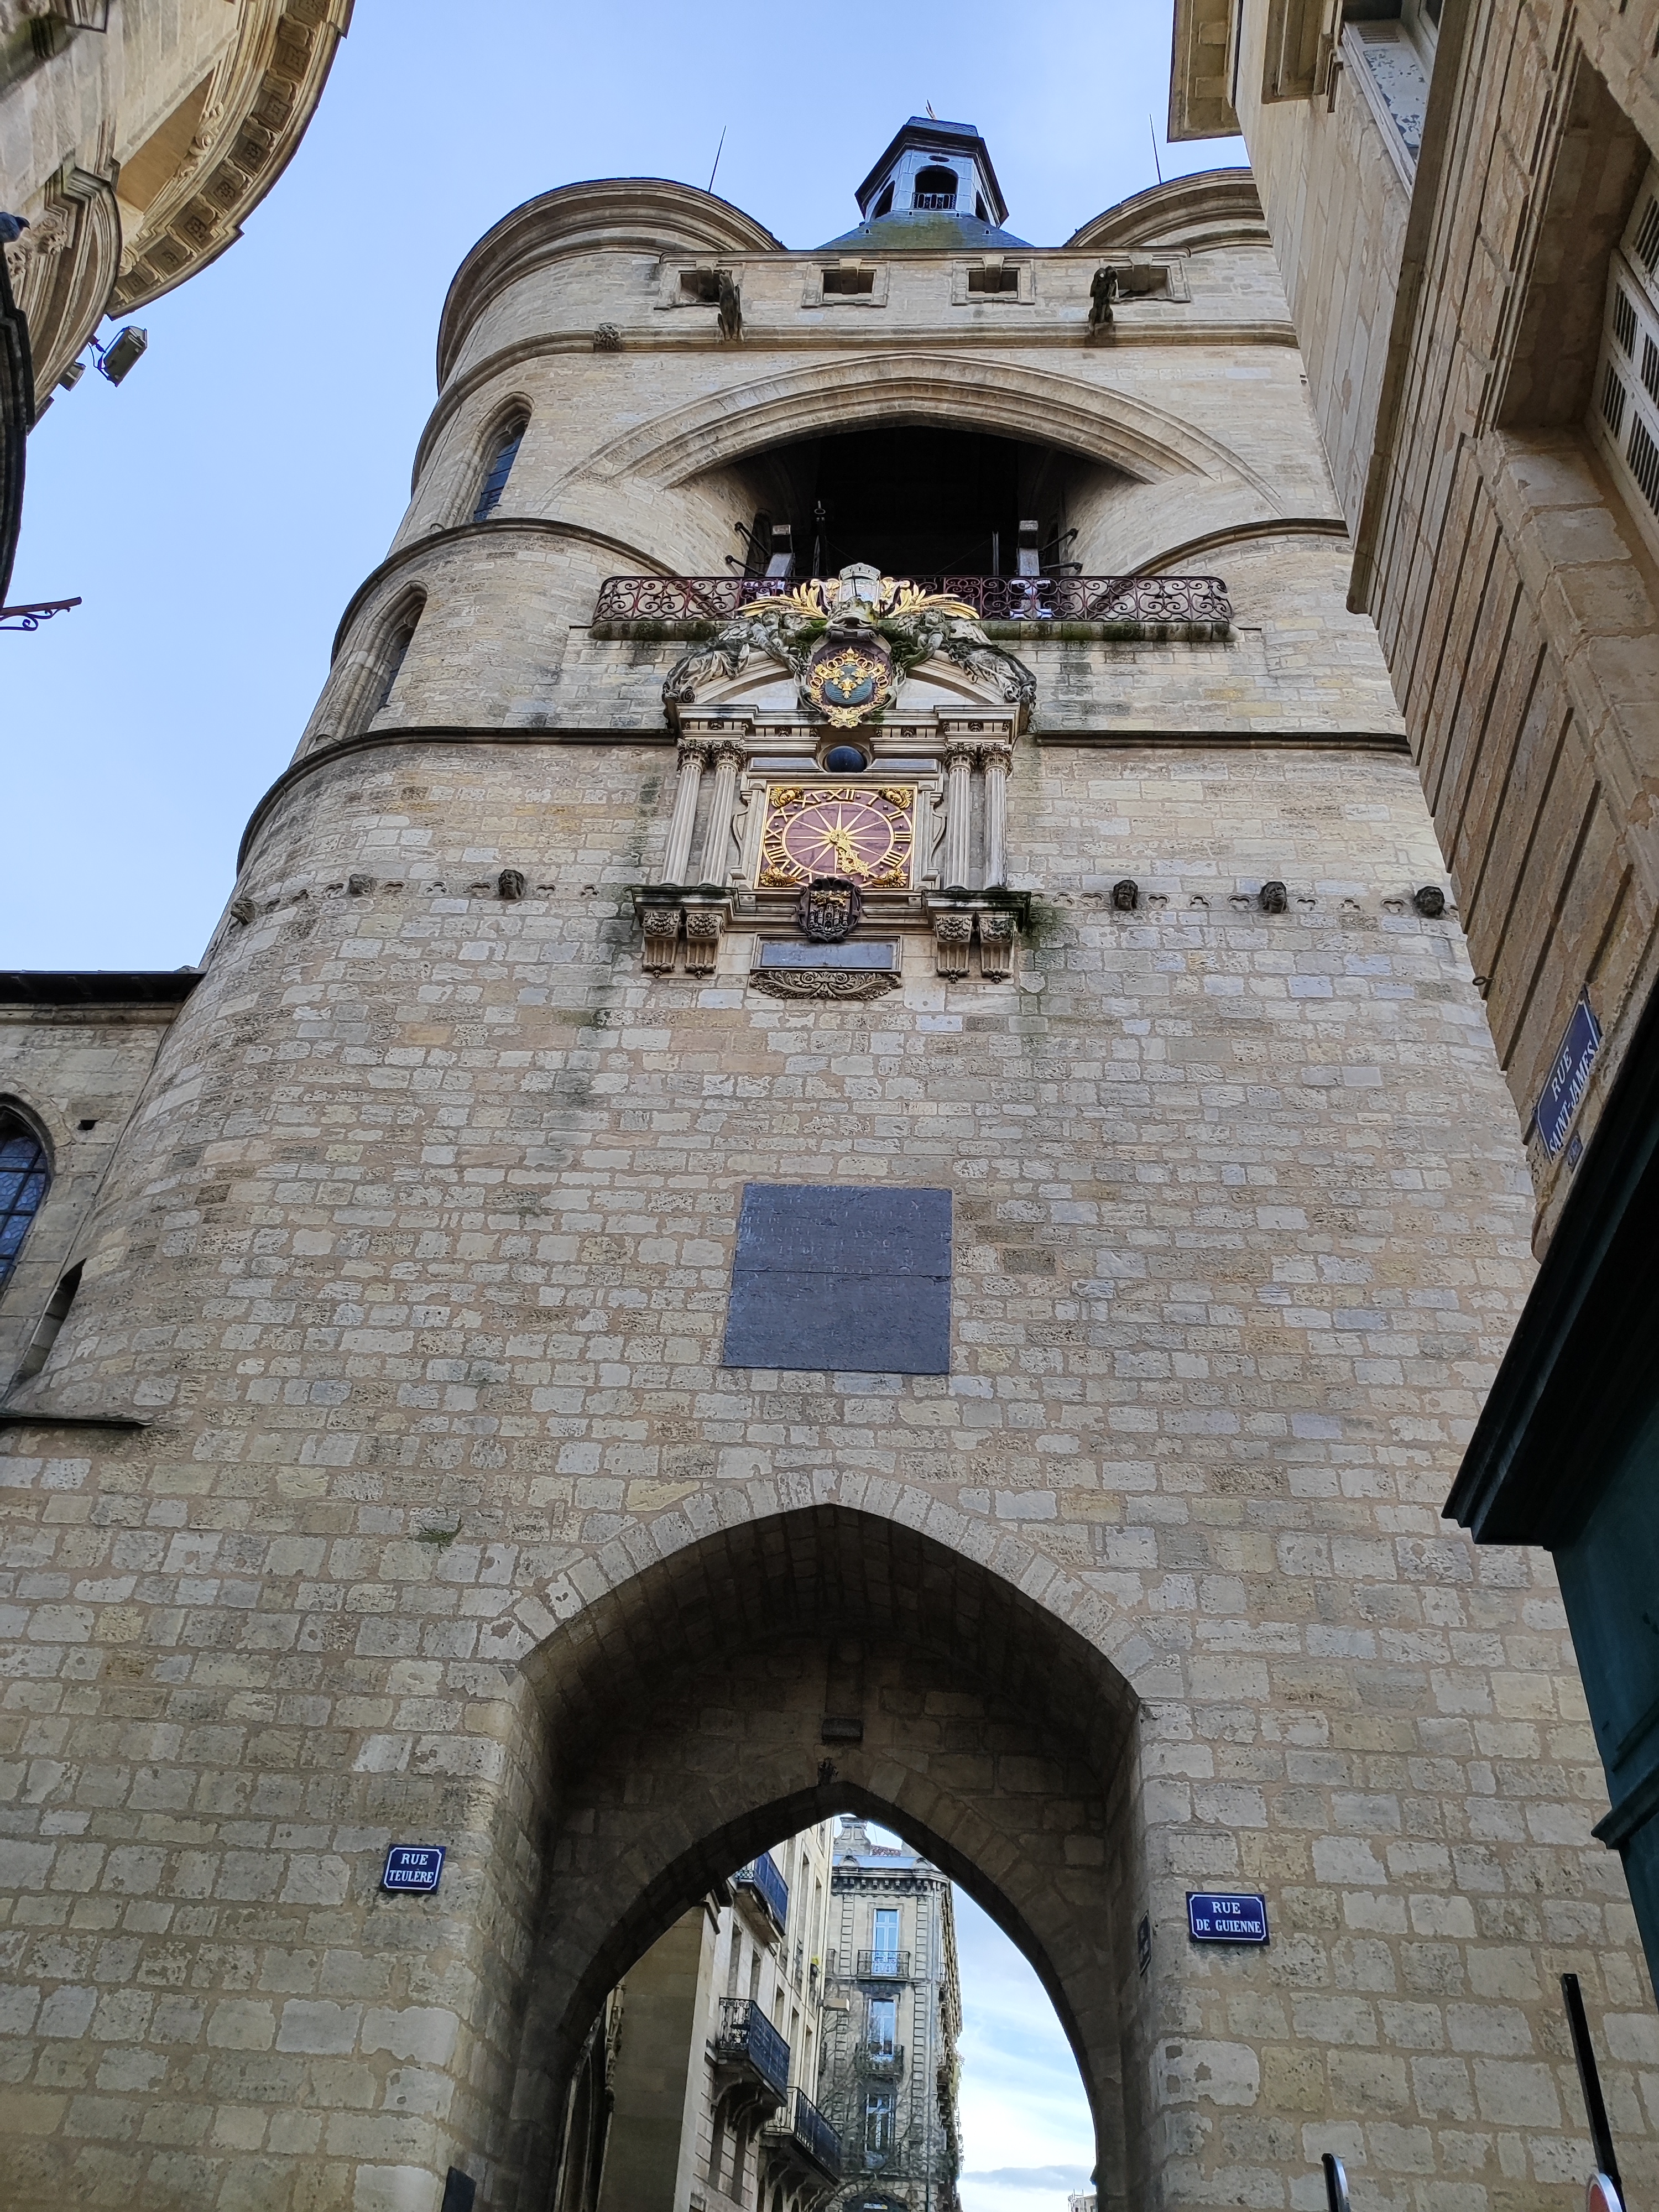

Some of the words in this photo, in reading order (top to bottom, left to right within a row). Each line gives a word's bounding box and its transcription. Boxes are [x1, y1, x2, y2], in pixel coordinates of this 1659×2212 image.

[826, 789, 855, 802] XII
[1551, 1045, 1572, 1102] RUE
[1549, 1039, 1595, 1155] SAINT-JAMES
[400, 1853, 429, 1865] RUE
[1212, 1901, 1241, 1914] RUE
[1196, 1918, 1211, 1931] DE
[1215, 1919, 1262, 1933] GUIENNE
